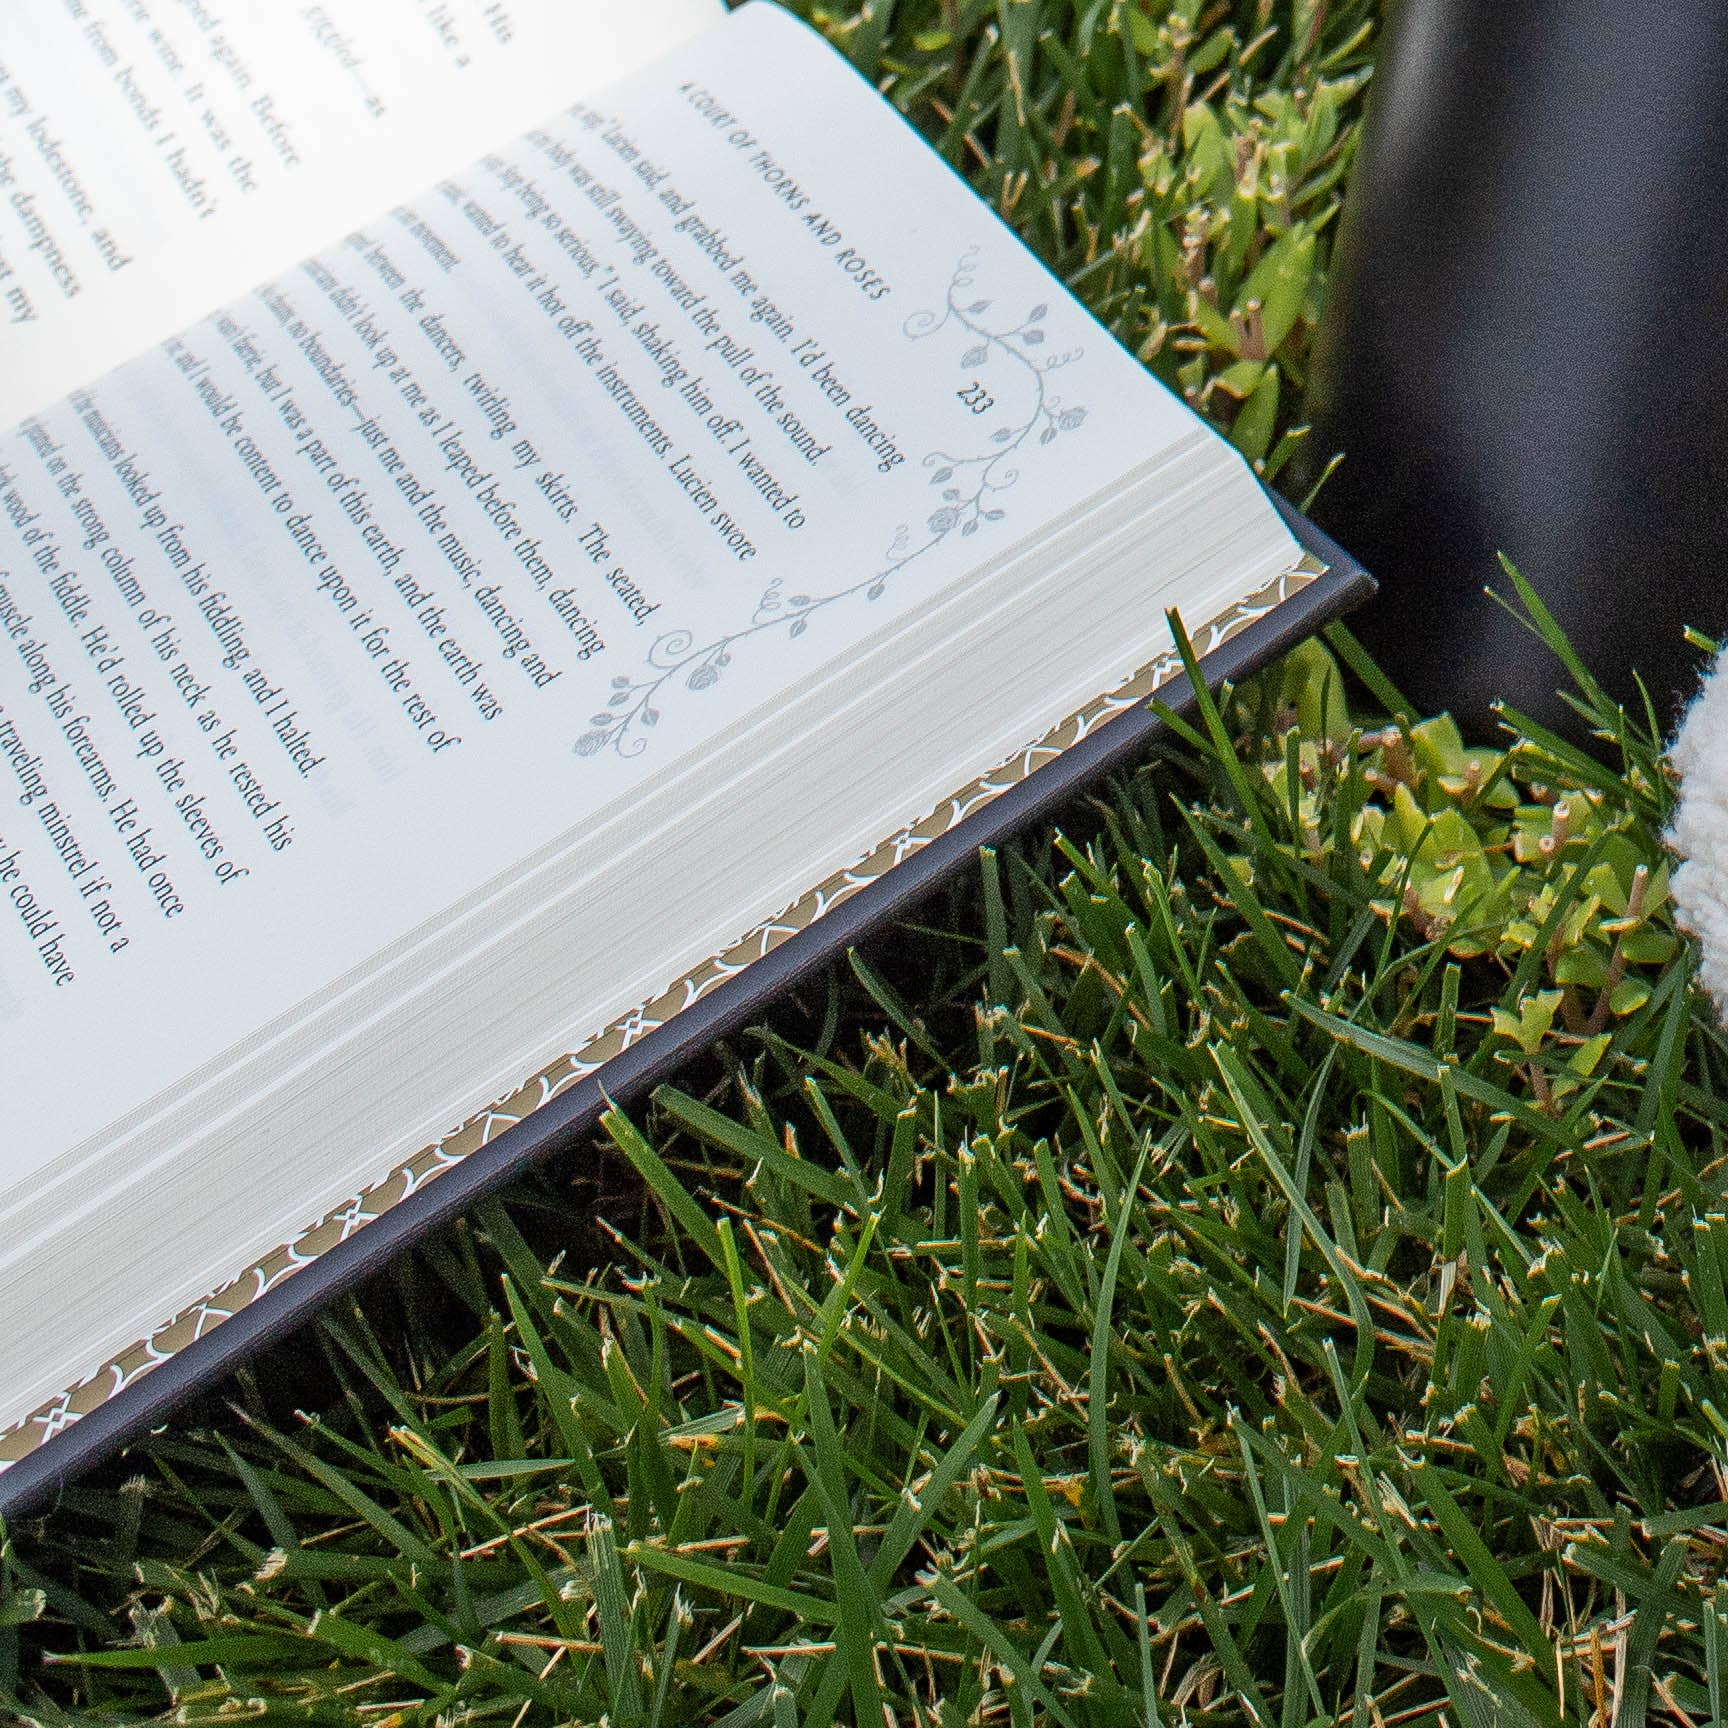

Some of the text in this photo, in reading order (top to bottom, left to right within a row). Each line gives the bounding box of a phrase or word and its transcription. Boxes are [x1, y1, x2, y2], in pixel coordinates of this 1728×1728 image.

[426, 3, 460, 48] like
[483, 2, 514, 45] His
[250, 93, 301, 167] Before
[227, 155, 258, 192] the
[25, 115, 134, 272] lodestone, and
[583, 183, 622, 210] still
[687, 89, 738, 130] COURT
[727, 129, 758, 150] OF
[749, 150, 811, 211] THORNS
[802, 213, 842, 246] AND
[835, 247, 891, 301] ROSES
[10, 192, 82, 299] dampness
[604, 206, 660, 266] swaying
[502, 243, 536, 278] hear
[525, 276, 547, 293] it
[536, 285, 567, 318] hot
[650, 258, 707, 312] toward
[7, 286, 38, 324] my
[691, 307, 721, 337] the
[352, 312, 389, 351] look
[557, 315, 595, 340] off
[657, 188, 905, 473] and grabbed me again. I’d been dancing
[371, 346, 399, 370] up
[574, 337, 604, 366] the
[704, 334, 755, 369] pull
[254, 363, 283, 395] but
[269, 386, 294, 403] I
[388, 366, 412, 385] at
[739, 366, 774, 387] of
[195, 376, 239, 419] would
[400, 381, 428, 409] me
[595, 364, 674, 460] instruments.
[596, 275, 806, 529] I said, shaking him off. I wanted to
[754, 384, 785, 414] the
[956, 381, 995, 415] 233
[219, 411, 244, 437] be
[278, 398, 307, 431] was
[417, 407, 441, 427] as
[431, 420, 455, 438] I
[295, 427, 314, 442] a
[776, 412, 833, 467] sound.
[233, 436, 283, 494] content
[295, 438, 338, 475] part
[398, 288, 426, 314] the
[418, 314, 467, 373] dancers,
[463, 372, 517, 441] twirling
[511, 439, 542, 470] my
[534, 471, 579, 524] skirts.
[577, 522, 611, 564] The
[605, 567, 662, 627] seated,
[438, 430, 493, 490] leaped
[326, 472, 361, 493] of
[668, 453, 718, 514] Lucien
[271, 491, 294, 514] to
[339, 490, 373, 526] this
[475, 482, 522, 541] before
[284, 514, 328, 565] dance
[361, 524, 405, 577] earth,
[709, 512, 757, 561] swore
[377, 446, 563, 689] me and the music, dancing and
[513, 538, 554, 592] them,
[316, 564, 358, 613] upon
[393, 573, 435, 609] and
[113, 453, 326, 779] looked up from his fiddling, and I halted.
[349, 609, 373, 631] it
[417, 606, 447, 639] the
[548, 588, 606, 661] dancing
[45, 456, 295, 852] on the strong column of his neck as he rested his
[360, 627, 391, 659] for
[437, 638, 483, 686] earth
[4, 489, 250, 885] wood of the fiddle. He’d rolled up the sleeves of
[380, 659, 411, 693] the
[402, 693, 437, 730] rest
[470, 682, 504, 721] was
[426, 730, 463, 754] of
[17, 639, 184, 919] along his forearms. He had once
[0, 720, 130, 954] traveling minstrel if not a
[0, 850, 75, 987] he could have
